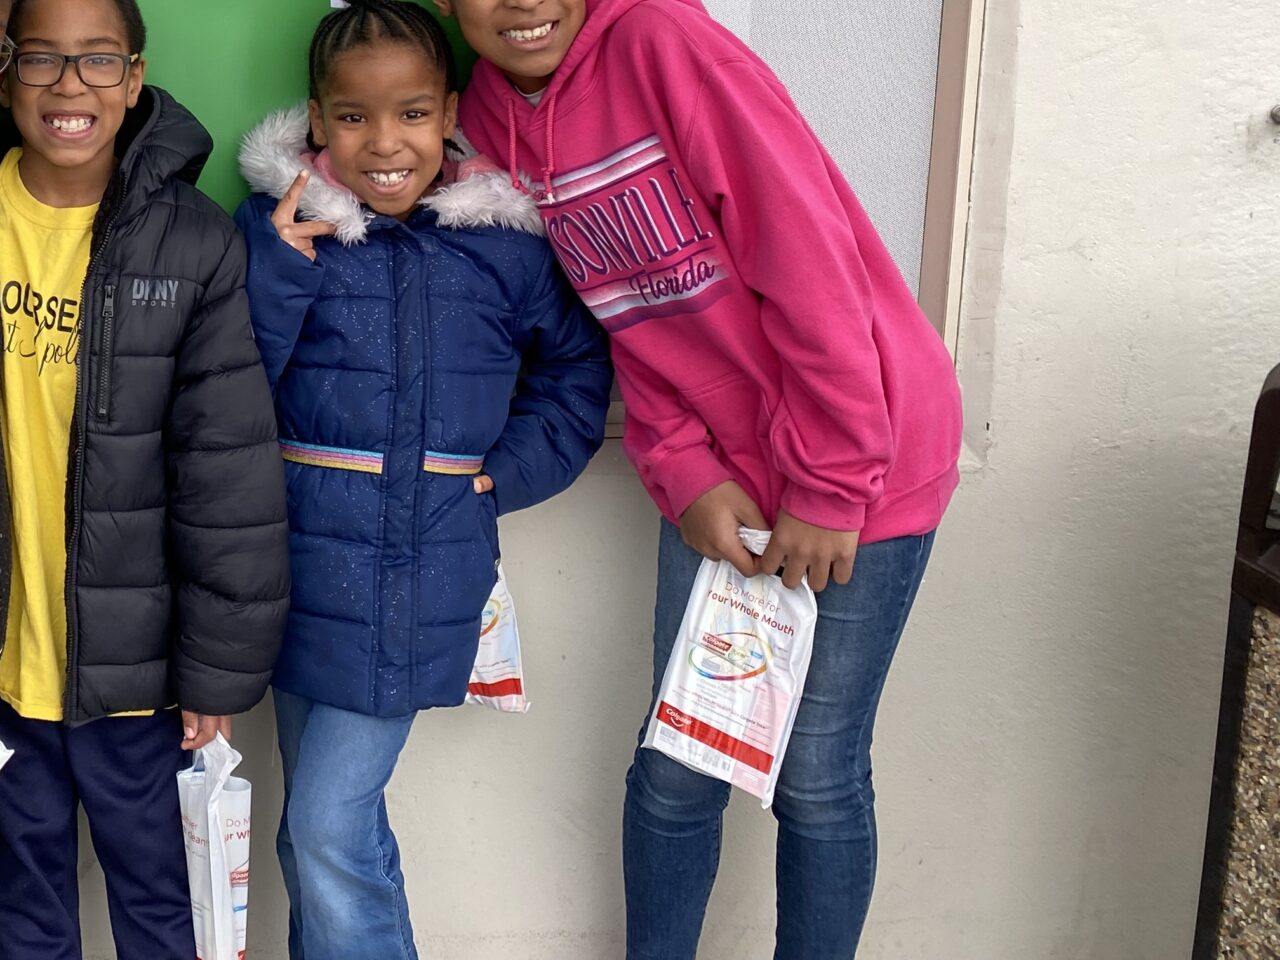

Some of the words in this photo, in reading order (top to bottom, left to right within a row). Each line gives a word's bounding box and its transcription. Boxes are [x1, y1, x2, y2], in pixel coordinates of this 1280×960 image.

[628, 256, 715, 305] Florida
[131, 299, 176, 309] SPORT
[740, 589, 765, 607] More
[730, 598, 760, 620] Whole
[761, 614, 795, 637] Mouth
